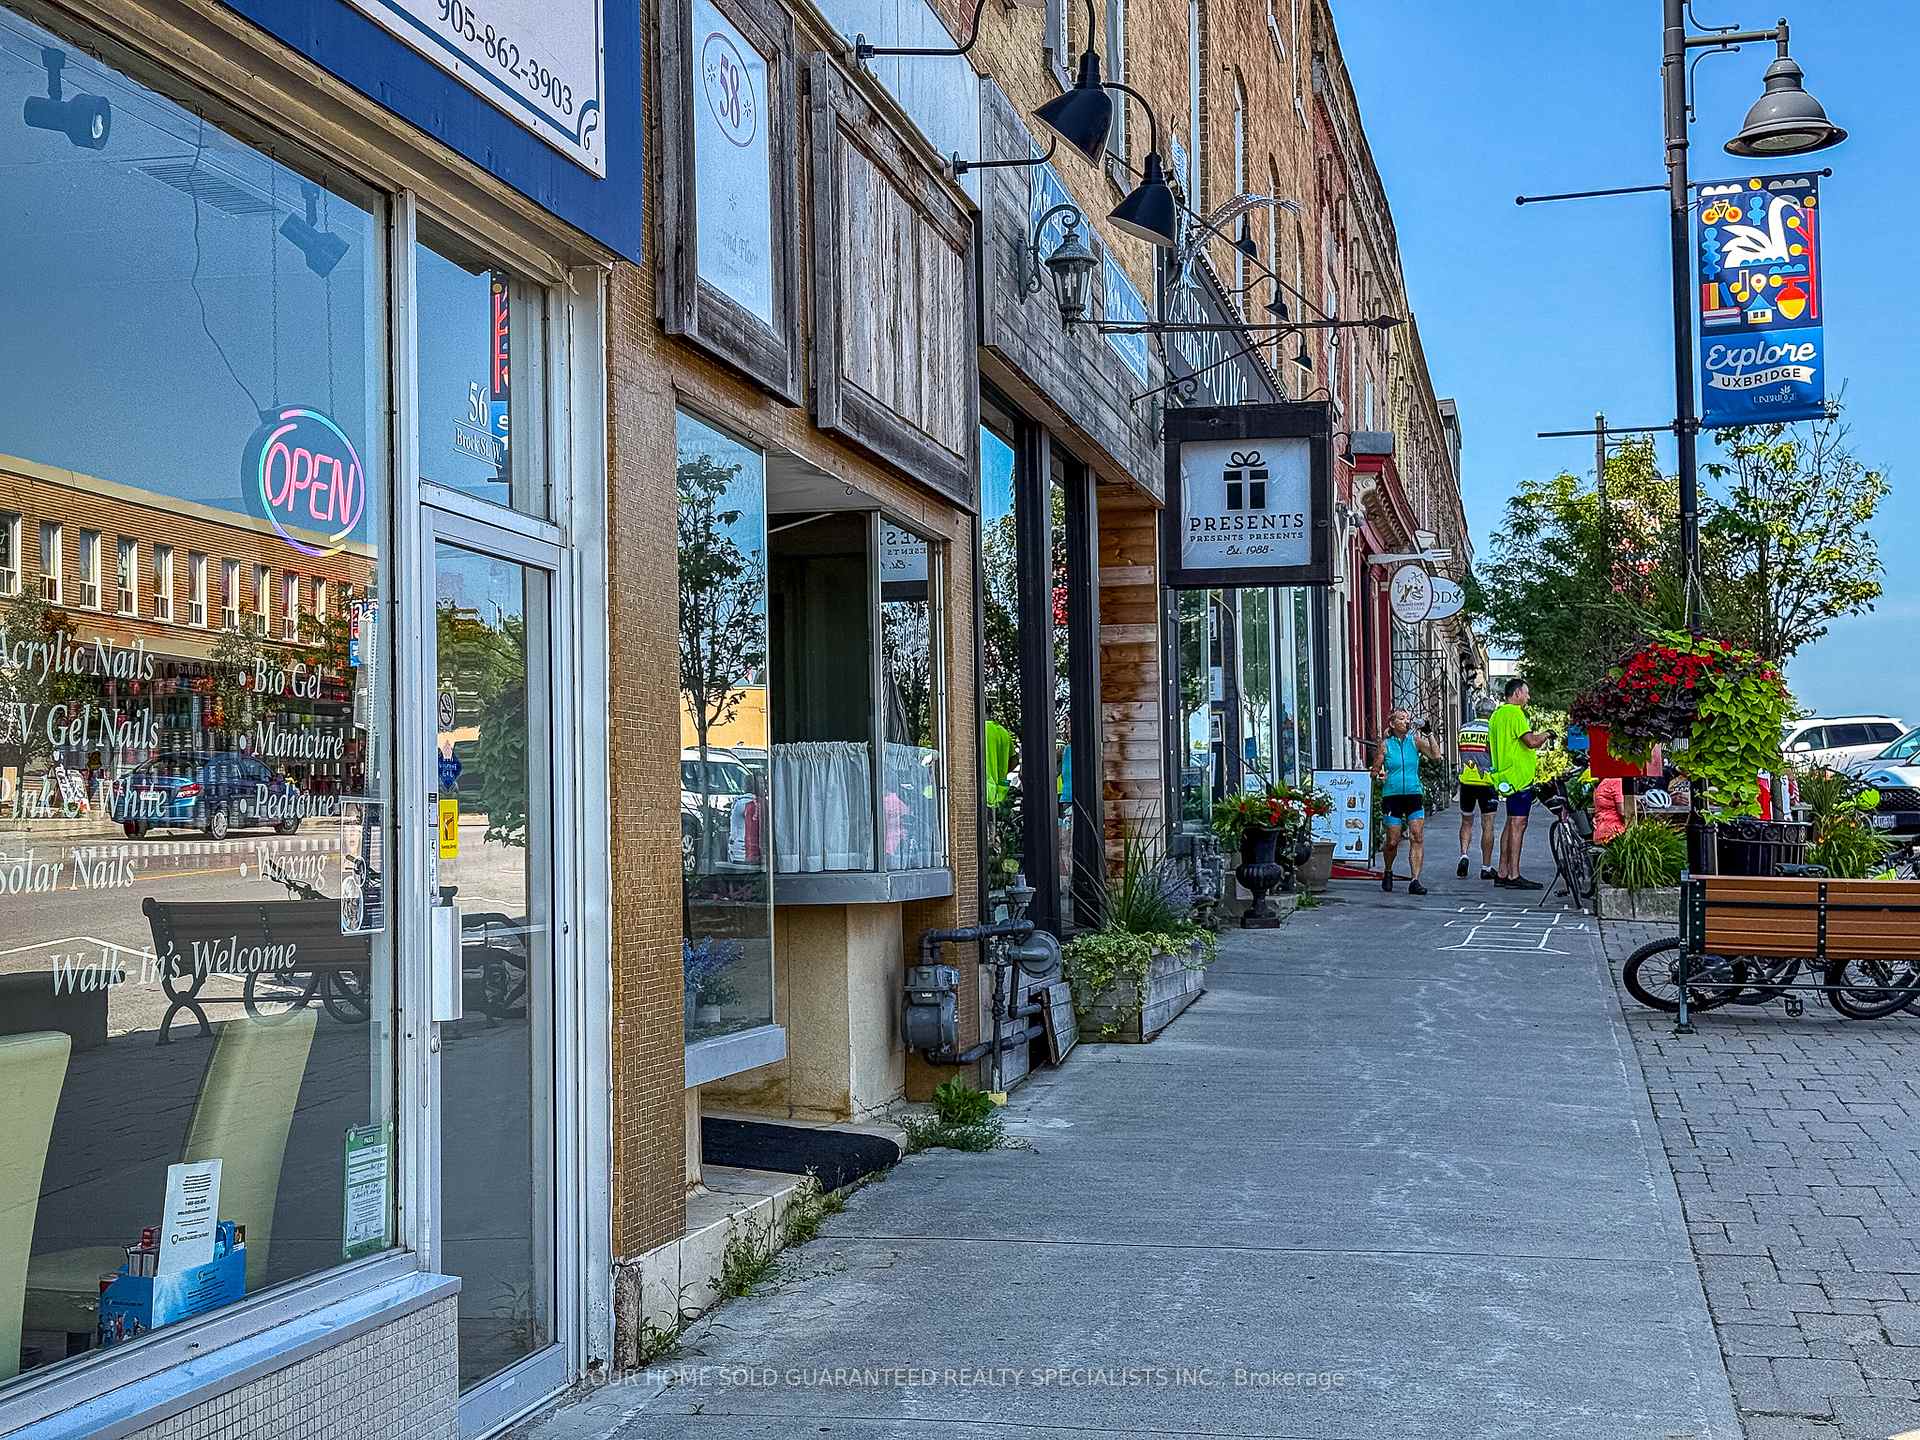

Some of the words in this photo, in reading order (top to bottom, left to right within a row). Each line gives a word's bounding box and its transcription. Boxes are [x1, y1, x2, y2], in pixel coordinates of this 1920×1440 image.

[437, 0, 573, 115] 905-862-3903
[719, 53, 741, 129] 58
[1705, 340, 1817, 377] Explore
[1721, 368, 1801, 388] UXBRIDGE
[468, 381, 488, 427] 56
[455, 427, 479, 453] Brock
[491, 443, 502, 462] W.
[264, 441, 355, 525] OPEN
[1190, 513, 1304, 531] PRESENTS
[1190, 534, 1244, 542] PRESENTS
[1249, 531, 1304, 540] PRESENTS
[93, 635, 155, 681] Nails
[252, 657, 285, 696] Bio
[291, 662, 322, 699] Gel
[47, 703, 91, 747] Gel
[96, 706, 160, 750] Nails
[251, 720, 345, 760] Manicure
[1460, 733, 1488, 741] ALPIN
[96, 774, 168, 819] White
[253, 782, 335, 819] Pedicure
[69, 845, 138, 892] Nails
[255, 846, 328, 891] Waxing
[191, 935, 297, 980] Welcome
